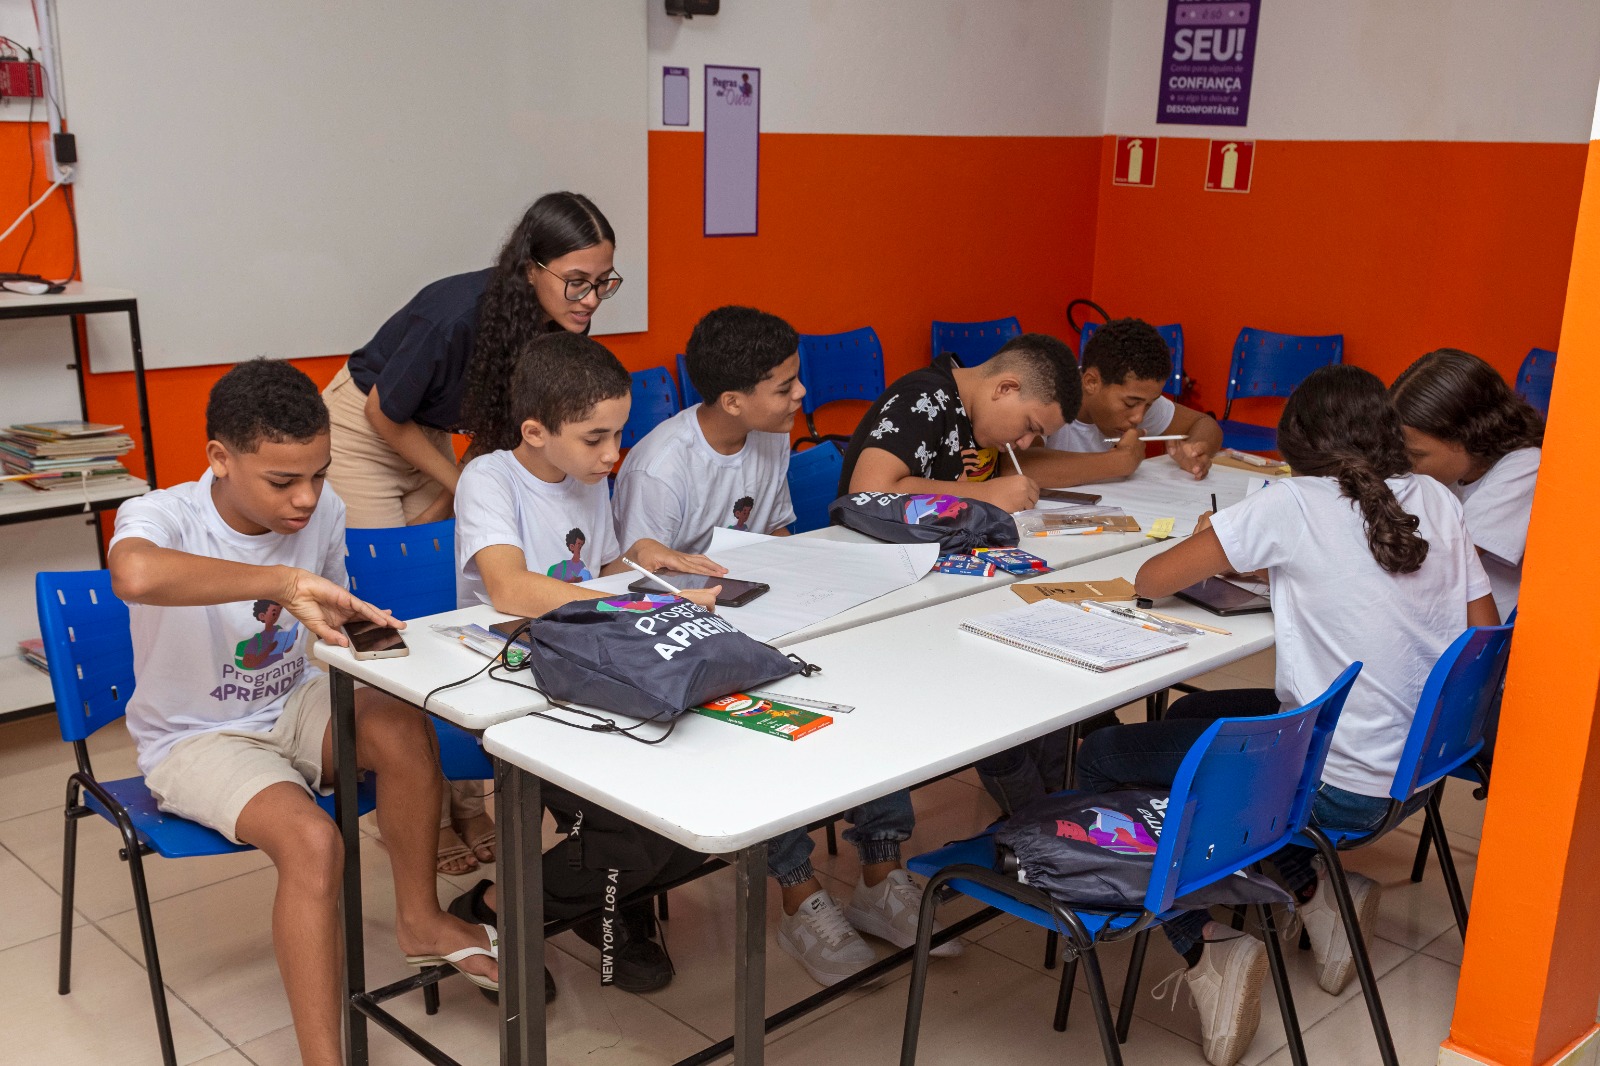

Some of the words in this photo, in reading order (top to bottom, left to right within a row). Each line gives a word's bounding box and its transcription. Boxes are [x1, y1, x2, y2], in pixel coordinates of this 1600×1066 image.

[1172, 28, 1246, 62] SEU!
[712, 77, 737, 89] Regras
[1169, 76, 1241, 93] CONFIANÇA
[1166, 104, 1239, 116] DESCONFORTÁVEL!
[222, 656, 304, 687] Programa
[604, 885, 616, 912] LOS
[603, 917, 614, 952] YORK
[602, 955, 614, 982] NEW
